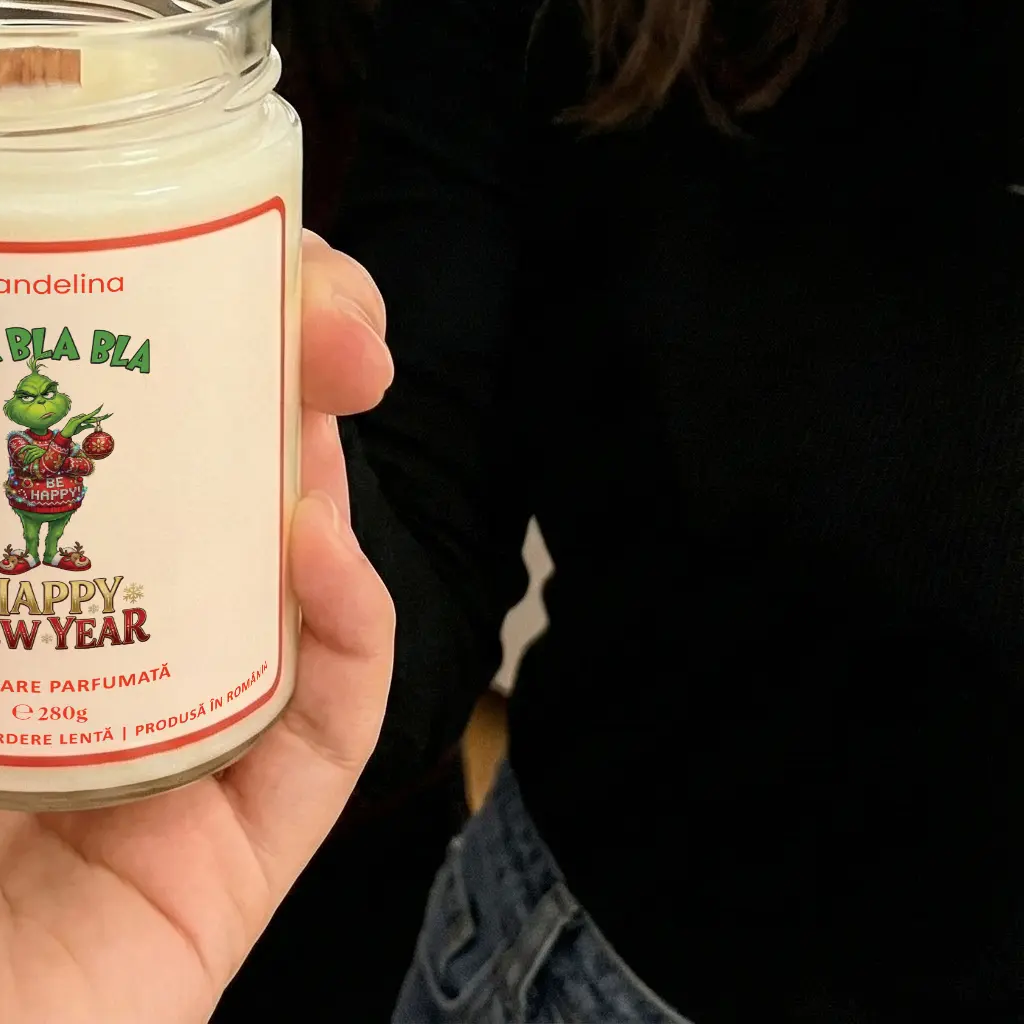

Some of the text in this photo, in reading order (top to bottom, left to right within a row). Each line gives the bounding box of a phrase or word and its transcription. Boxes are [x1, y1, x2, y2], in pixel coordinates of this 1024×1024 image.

[5, 326, 81, 362] BLA
[90, 329, 150, 374] BLA
[46, 476, 64, 488] BE
[47, 607, 151, 650] YEAR
[49, 662, 171, 693] PARFUMATĂ
[37, 705, 89, 723] 280g
[59, 727, 114, 745] LENTĂ
[135, 702, 206, 737] PRODUSĂ
[210, 696, 223, 712] ÎN
